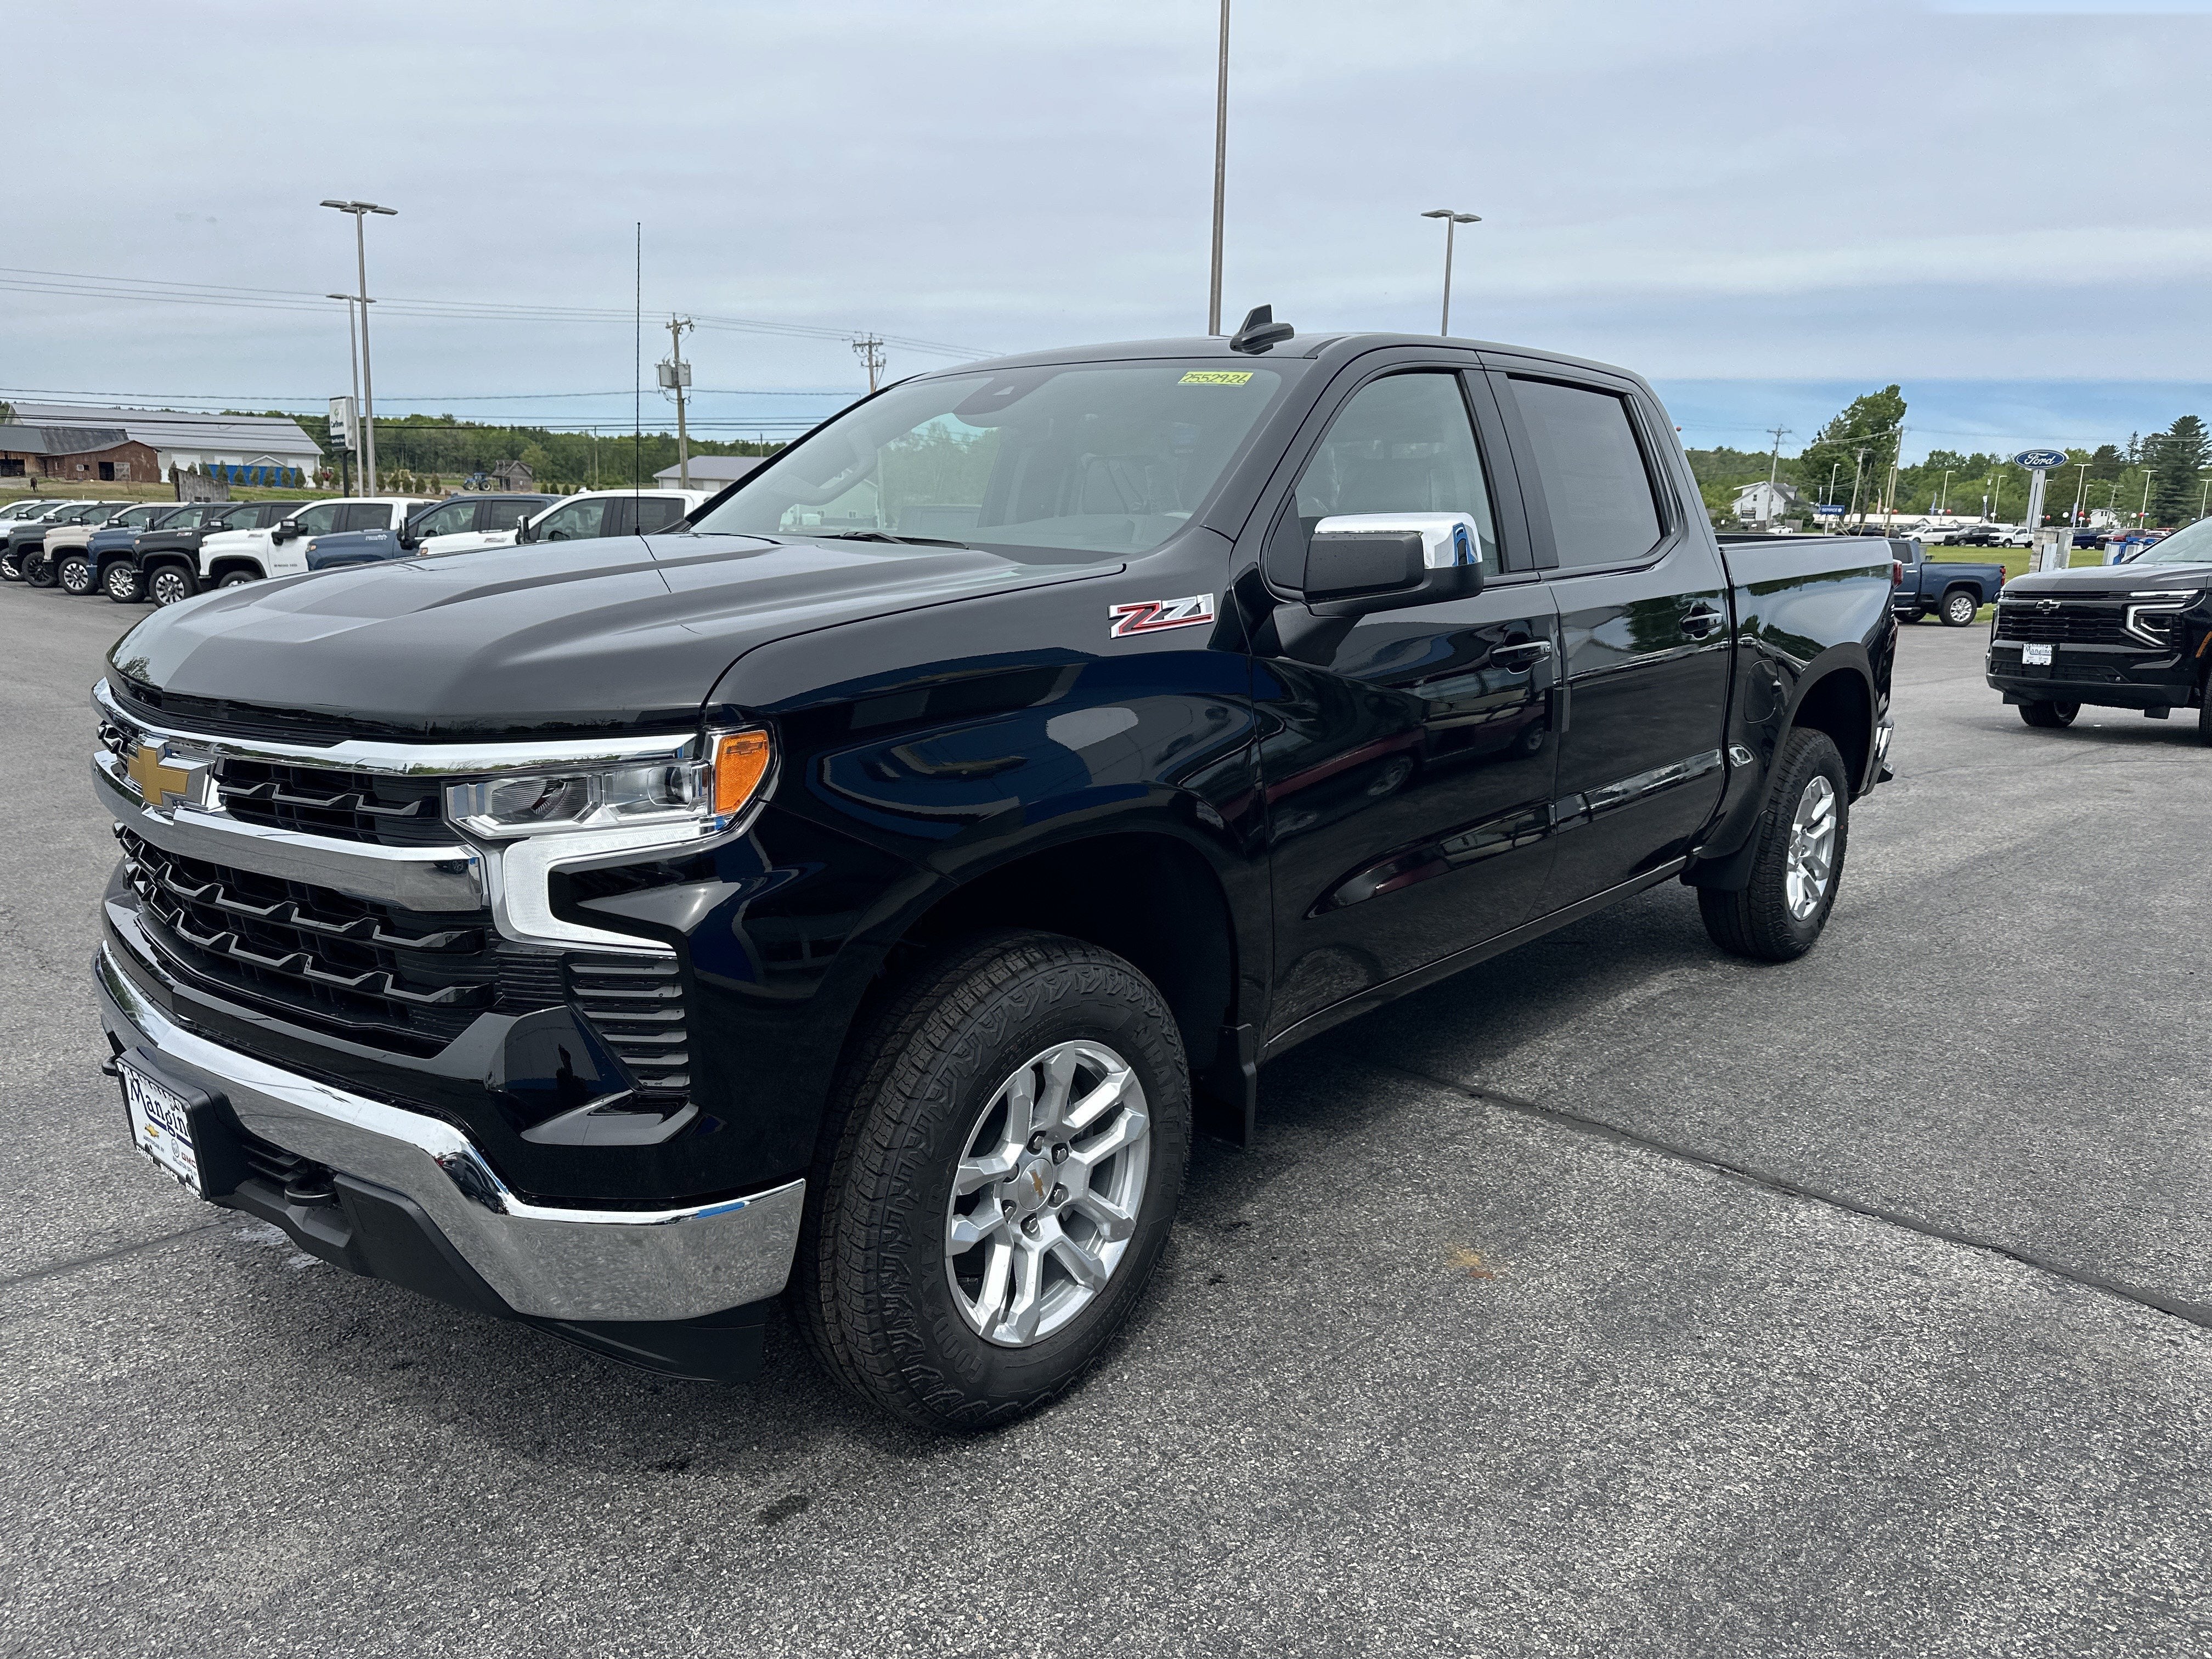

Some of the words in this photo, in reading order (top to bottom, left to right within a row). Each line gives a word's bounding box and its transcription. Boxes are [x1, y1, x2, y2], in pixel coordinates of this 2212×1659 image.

[2024, 453, 2056, 465] Ford
[1108, 593, 1215, 639] Z71
[130, 1078, 189, 1137] Mangin
[1131, 1022, 1179, 1196] WRANGLER
[136, 1145, 154, 1164] CHEVY
[160, 1163, 179, 1183] BUICK
[185, 1182, 201, 1199] GMC
[182, 1152, 196, 1169] GMC
